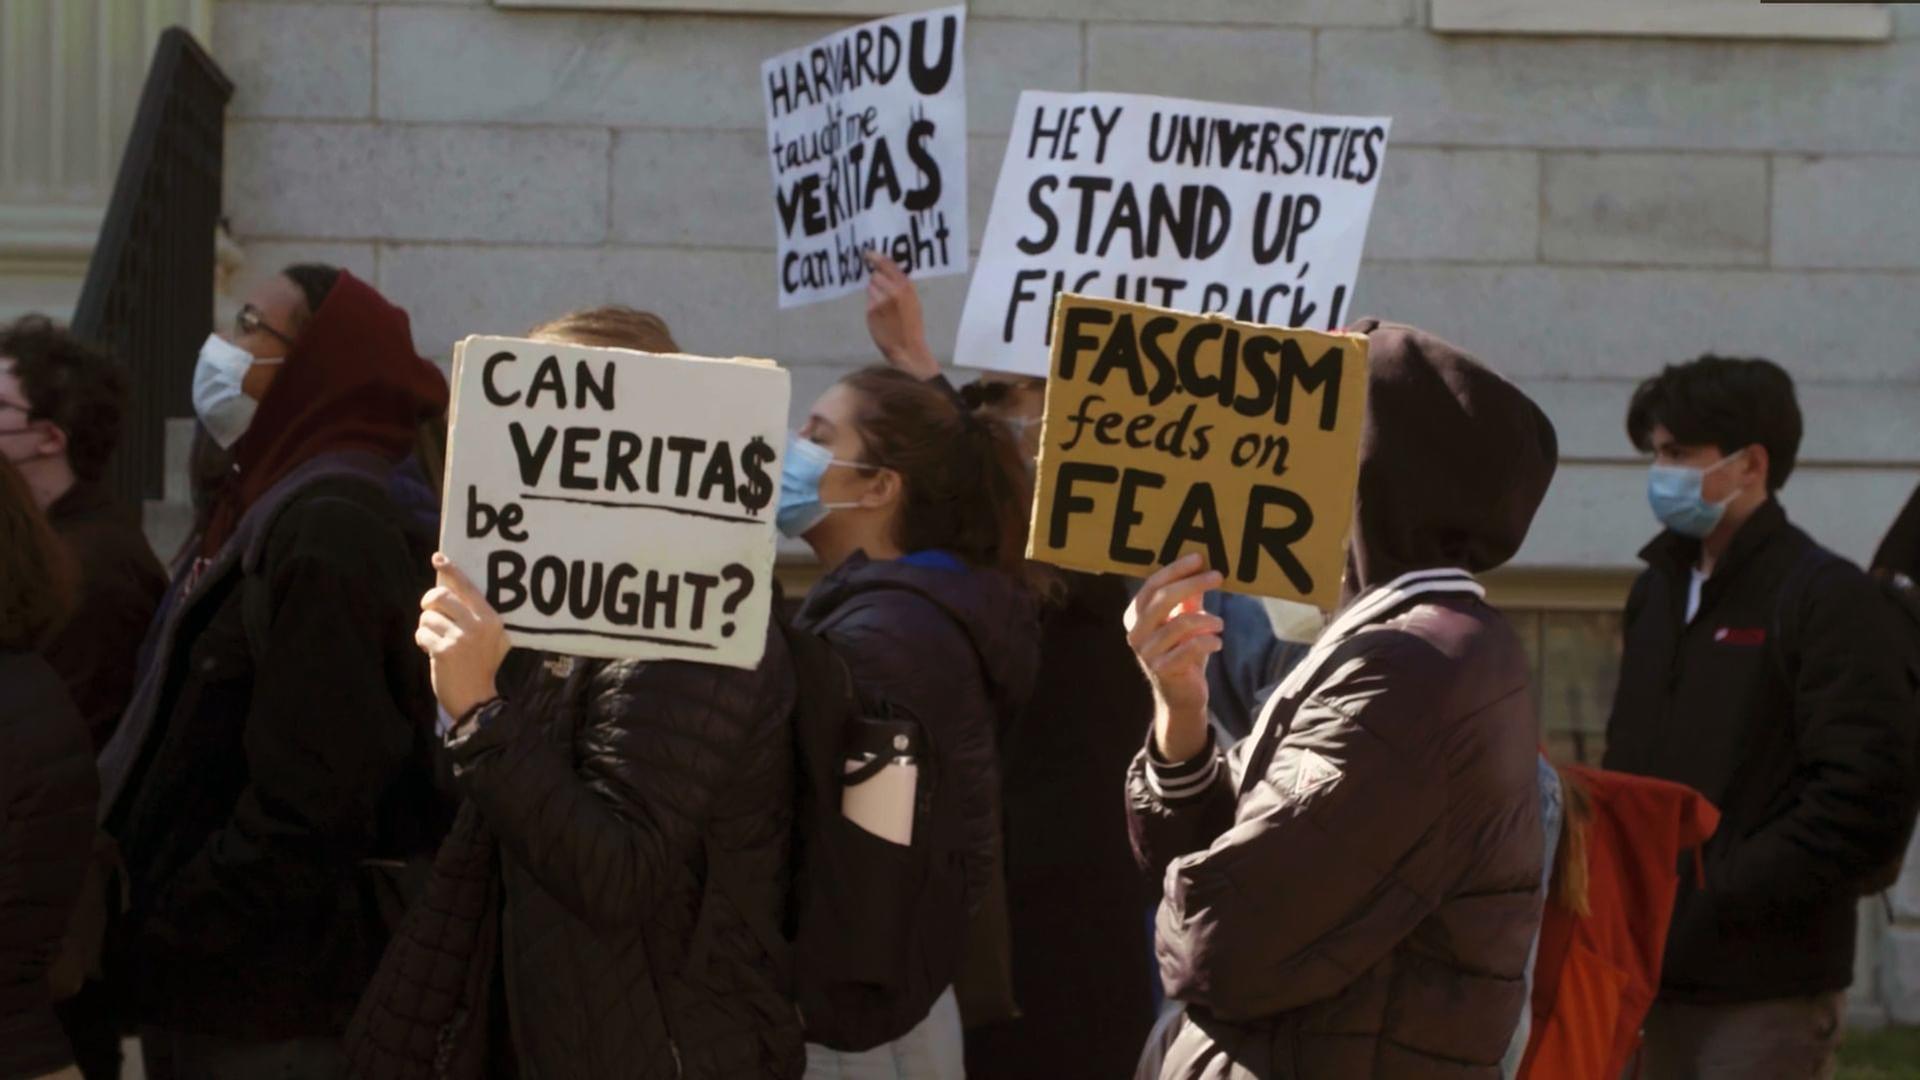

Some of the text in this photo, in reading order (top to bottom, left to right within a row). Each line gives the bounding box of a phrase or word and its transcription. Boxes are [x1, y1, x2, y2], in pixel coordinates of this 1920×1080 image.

[769, 15, 957, 118] HARVARD U
[1027, 105, 1385, 185] HEY UNIVERSITIES
[783, 246, 834, 294] can
[1016, 174, 1321, 280] STAND UP,
[482, 351, 616, 411] CAN
[1058, 306, 1344, 431] FASCISM
[508, 421, 777, 516] VERITA$
[1059, 395, 1290, 477] feeds on
[466, 484, 529, 542] be
[1048, 461, 1314, 595] FEAR
[486, 549, 755, 639] BOUGHT?
